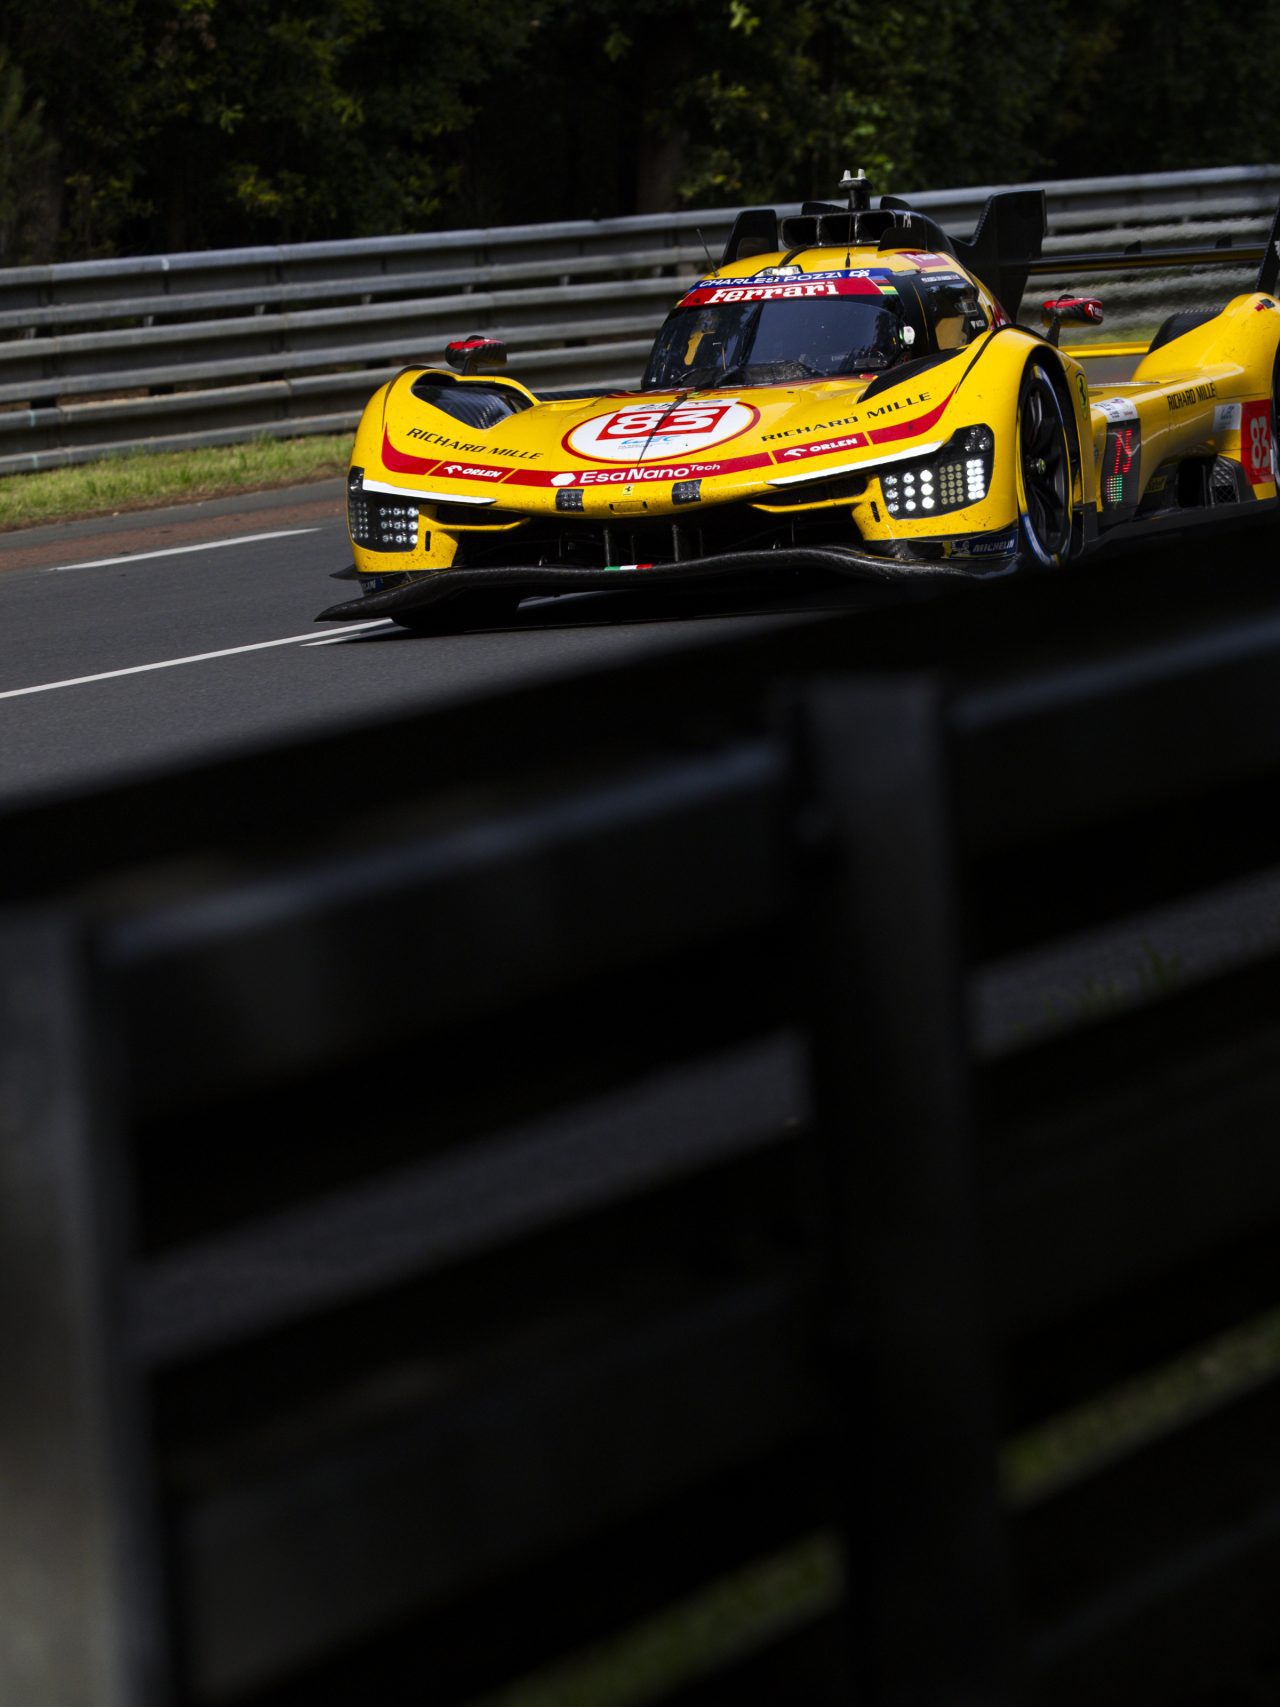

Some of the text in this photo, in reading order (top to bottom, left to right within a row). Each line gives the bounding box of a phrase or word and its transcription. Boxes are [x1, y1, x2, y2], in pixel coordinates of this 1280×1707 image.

[699, 276, 780, 289] CHARLES
[783, 271, 843, 282] POZZI
[703, 281, 840, 304] Ferrari
[1166, 382, 1217, 411] RICHARD MILLE
[607, 408, 722, 435] 83
[760, 392, 932, 442] RICHARD MILLE
[406, 427, 544, 460] RICHARD MILLE
[809, 438, 858, 453] ORLEN
[1250, 415, 1271, 469] 83
[461, 467, 503, 478] ORLEN
